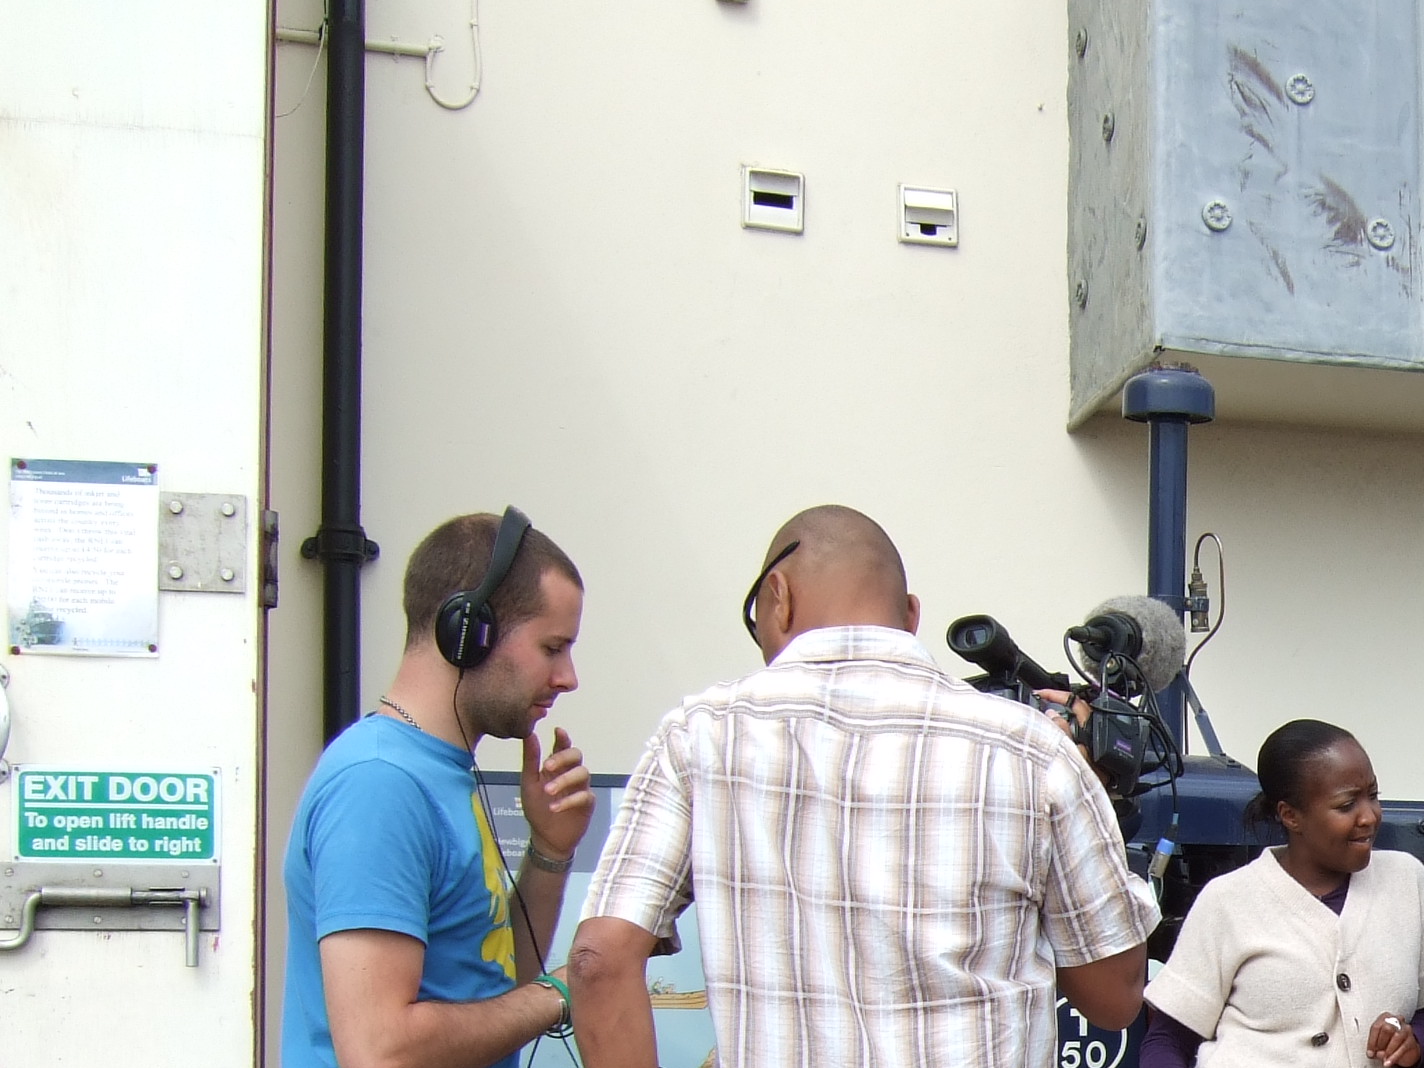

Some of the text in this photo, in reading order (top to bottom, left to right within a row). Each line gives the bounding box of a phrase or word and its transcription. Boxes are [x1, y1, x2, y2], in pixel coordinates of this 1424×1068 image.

[24, 775, 209, 803] EXIT DOOR
[24, 812, 209, 832] To open lift handle
[32, 835, 202, 856] and slide to right
[1070, 1008, 1088, 1037] 1
